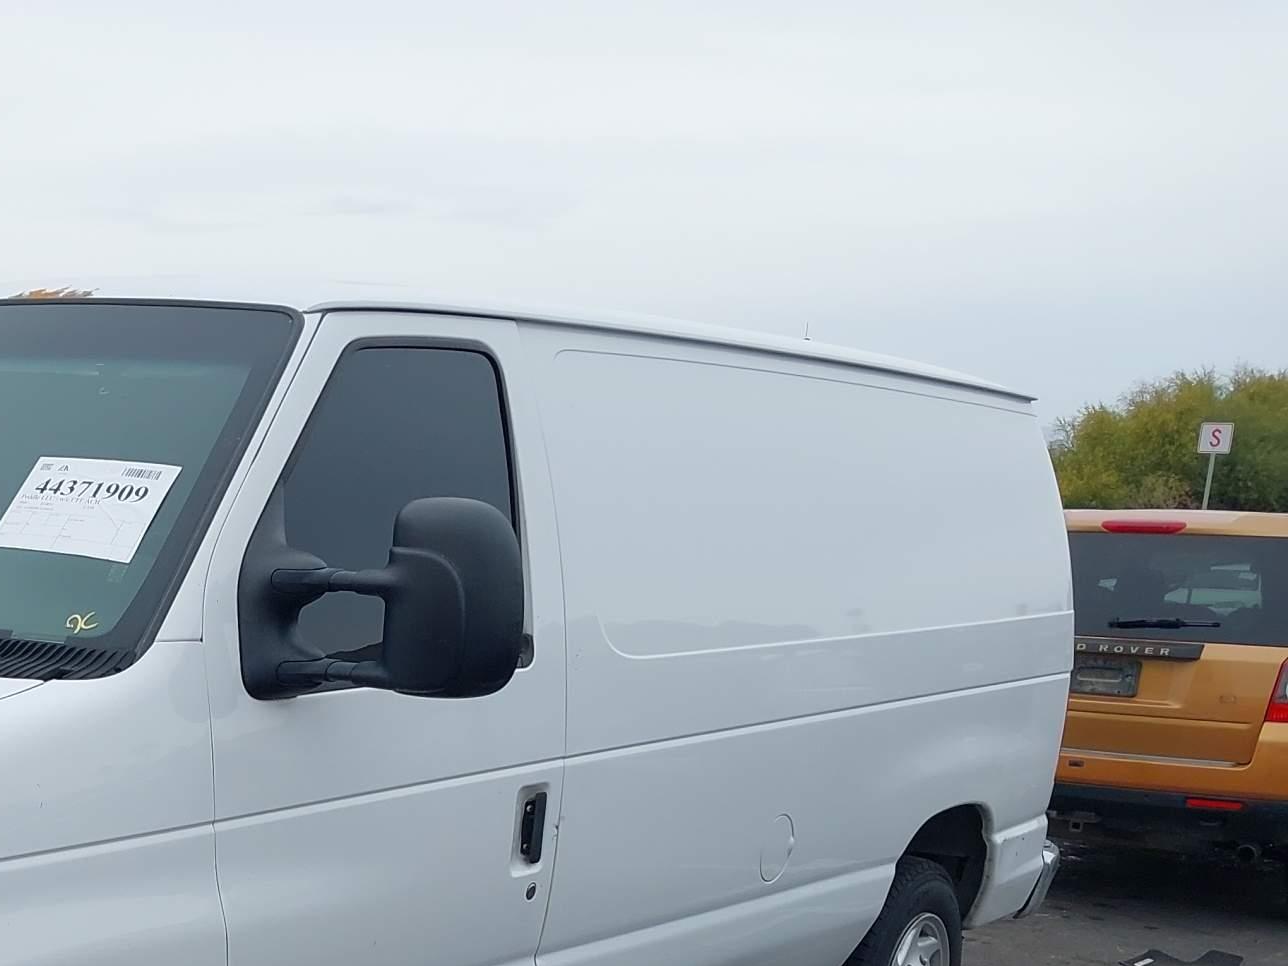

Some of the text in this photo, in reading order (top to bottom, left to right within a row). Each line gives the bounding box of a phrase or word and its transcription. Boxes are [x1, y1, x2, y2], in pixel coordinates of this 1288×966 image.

[1209, 428, 1223, 448] S
[34, 477, 150, 503] 44371909
[1098, 644, 1171, 656] ROVER
